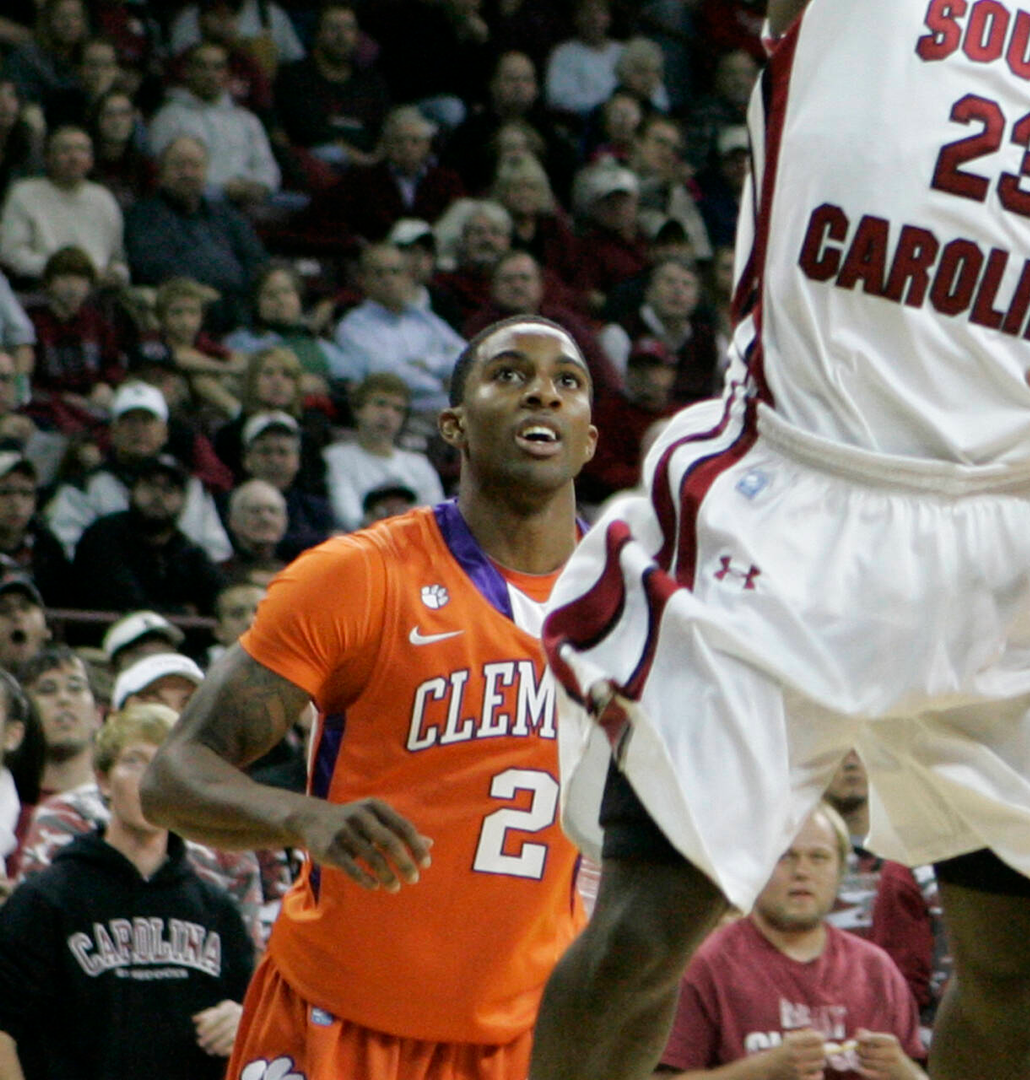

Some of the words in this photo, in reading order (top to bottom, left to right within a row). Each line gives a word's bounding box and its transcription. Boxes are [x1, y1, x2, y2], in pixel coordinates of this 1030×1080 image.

[406, 660, 557, 752] CLEM
[472, 767, 560, 882] 2
[67, 917, 221, 978] CAROLINA
